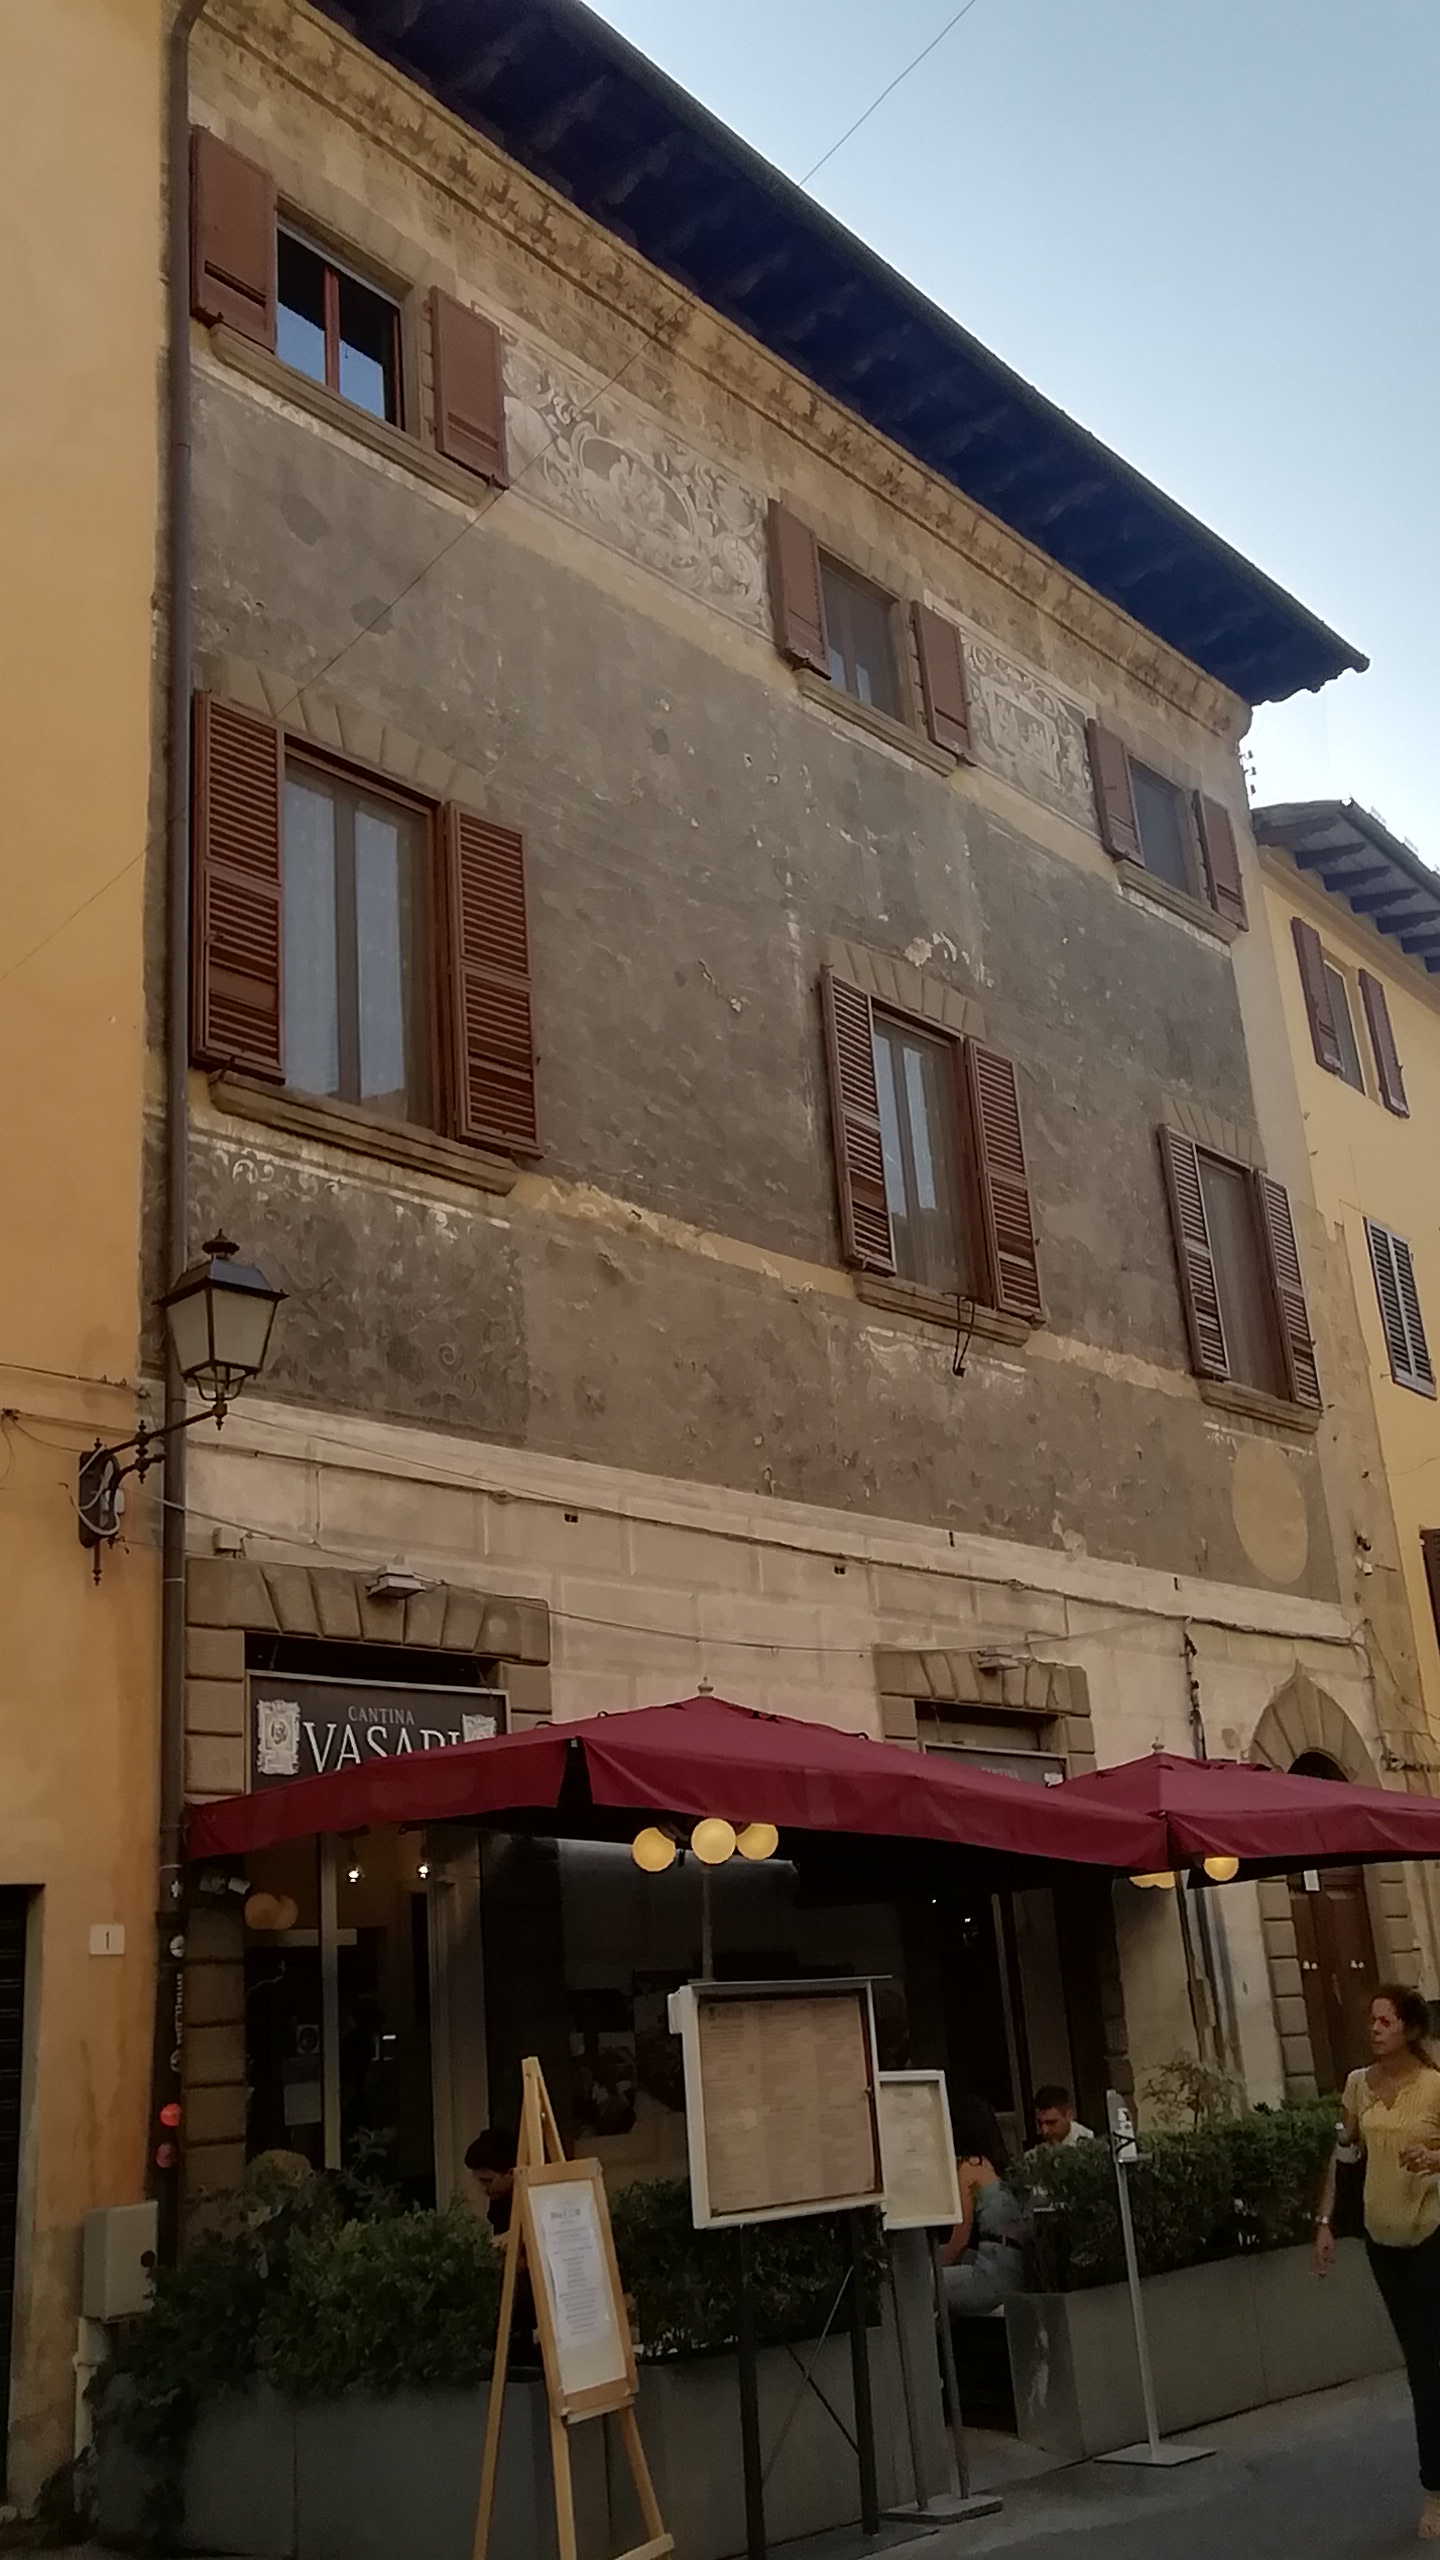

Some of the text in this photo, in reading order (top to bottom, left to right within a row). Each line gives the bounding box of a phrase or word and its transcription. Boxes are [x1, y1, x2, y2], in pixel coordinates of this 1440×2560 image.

[348, 1705, 416, 1726] CANTINA
[302, 1721, 461, 1773] VASA
[105, 1931, 110, 1950] 1
